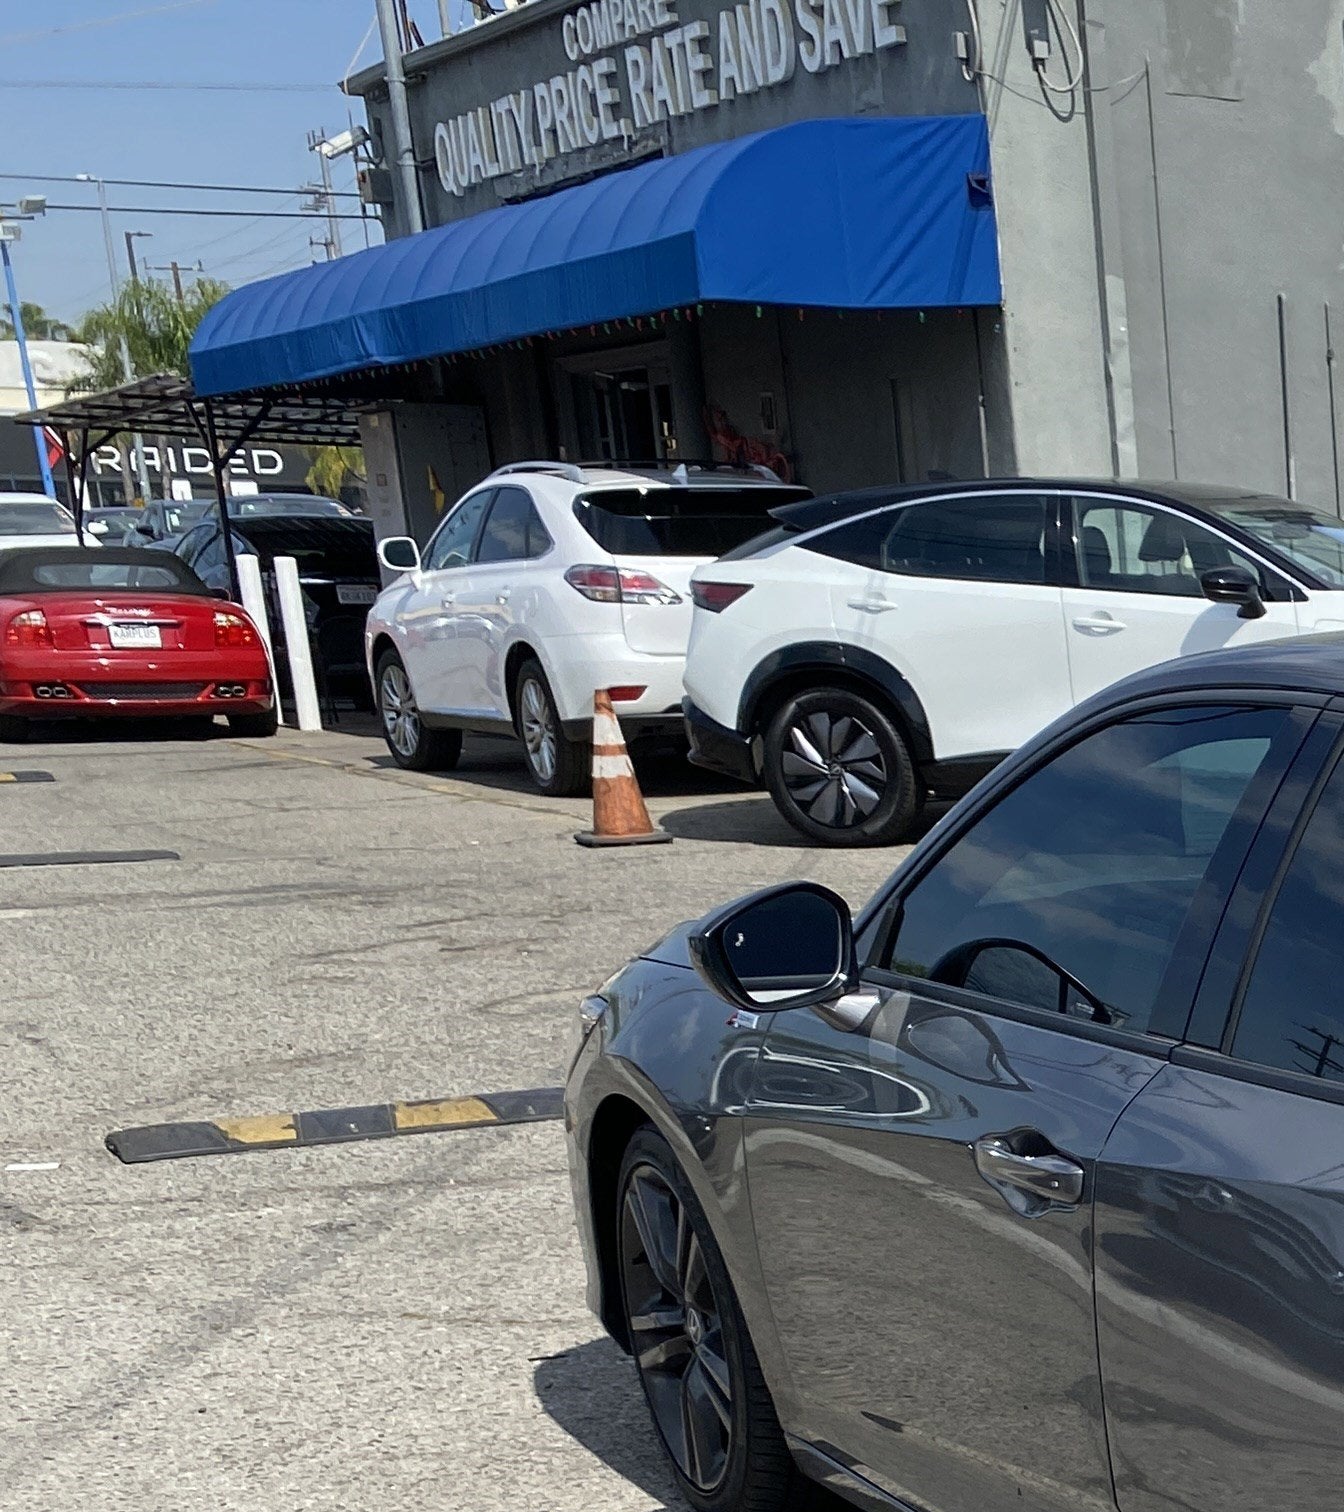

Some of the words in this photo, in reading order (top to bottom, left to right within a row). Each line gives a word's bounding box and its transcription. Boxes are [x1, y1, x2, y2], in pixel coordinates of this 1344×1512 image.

[562, 0, 678, 61] COMPARE
[624, 20, 718, 129] RATE
[719, 0, 796, 100] AND
[795, 0, 907, 73] SAVE
[90, 445, 284, 475] RAIDED
